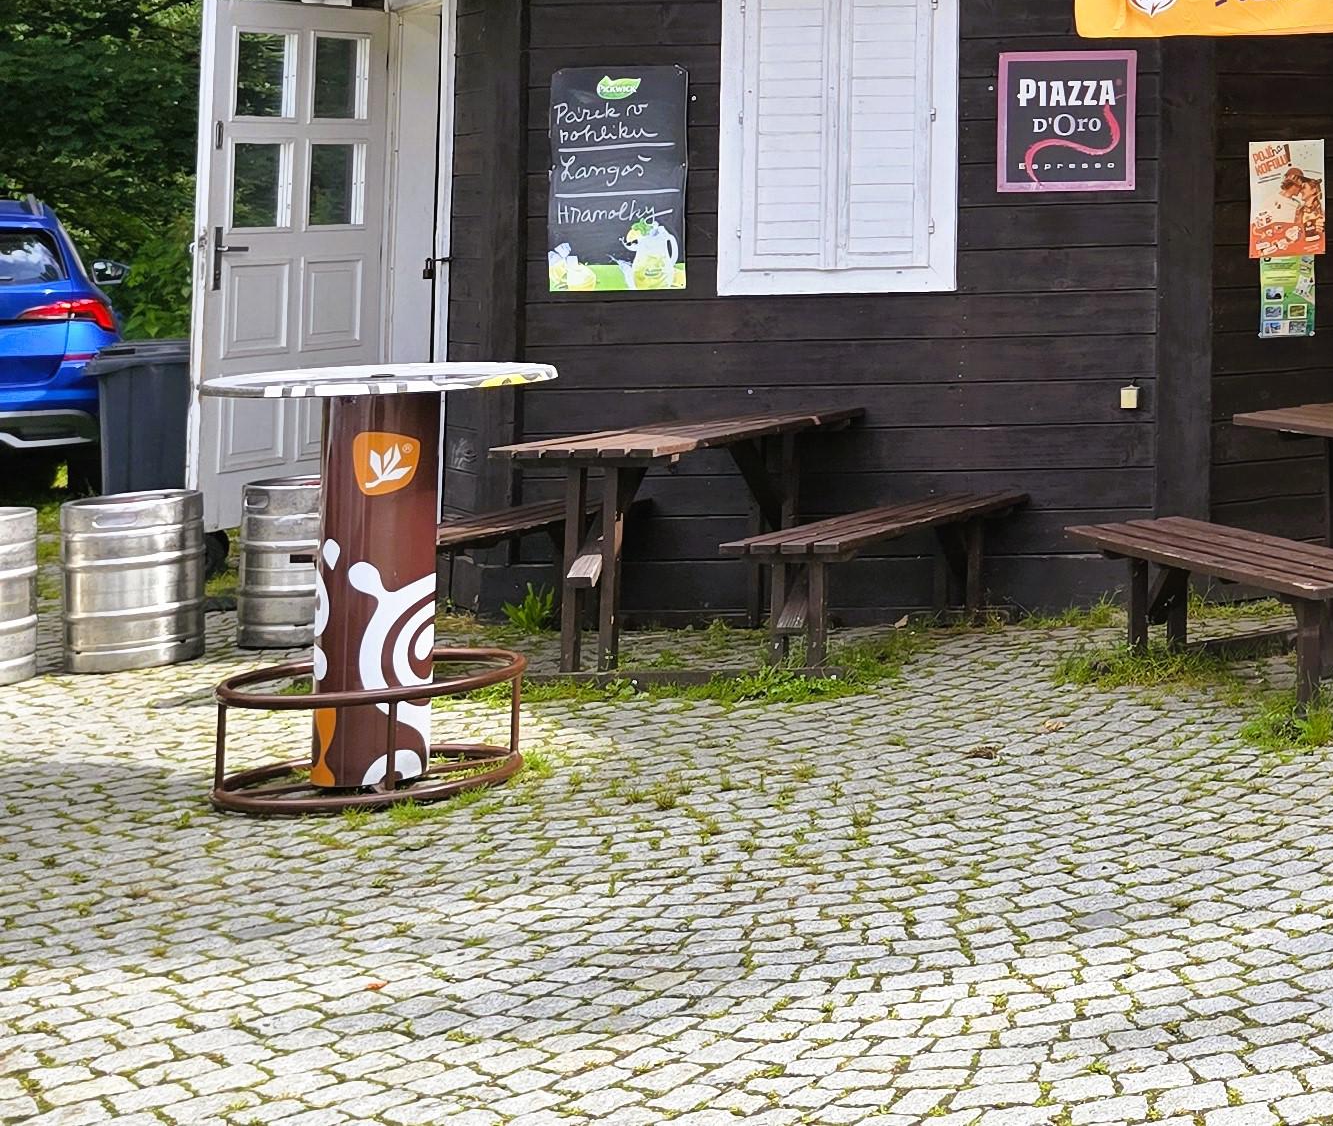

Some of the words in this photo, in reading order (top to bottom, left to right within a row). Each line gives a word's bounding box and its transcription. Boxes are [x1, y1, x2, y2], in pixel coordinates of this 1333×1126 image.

[598, 84, 638, 94] PICKWICK
[1017, 78, 1116, 107] PIAZZA
[626, 103, 649, 117] v
[560, 154, 652, 187] Langoš
